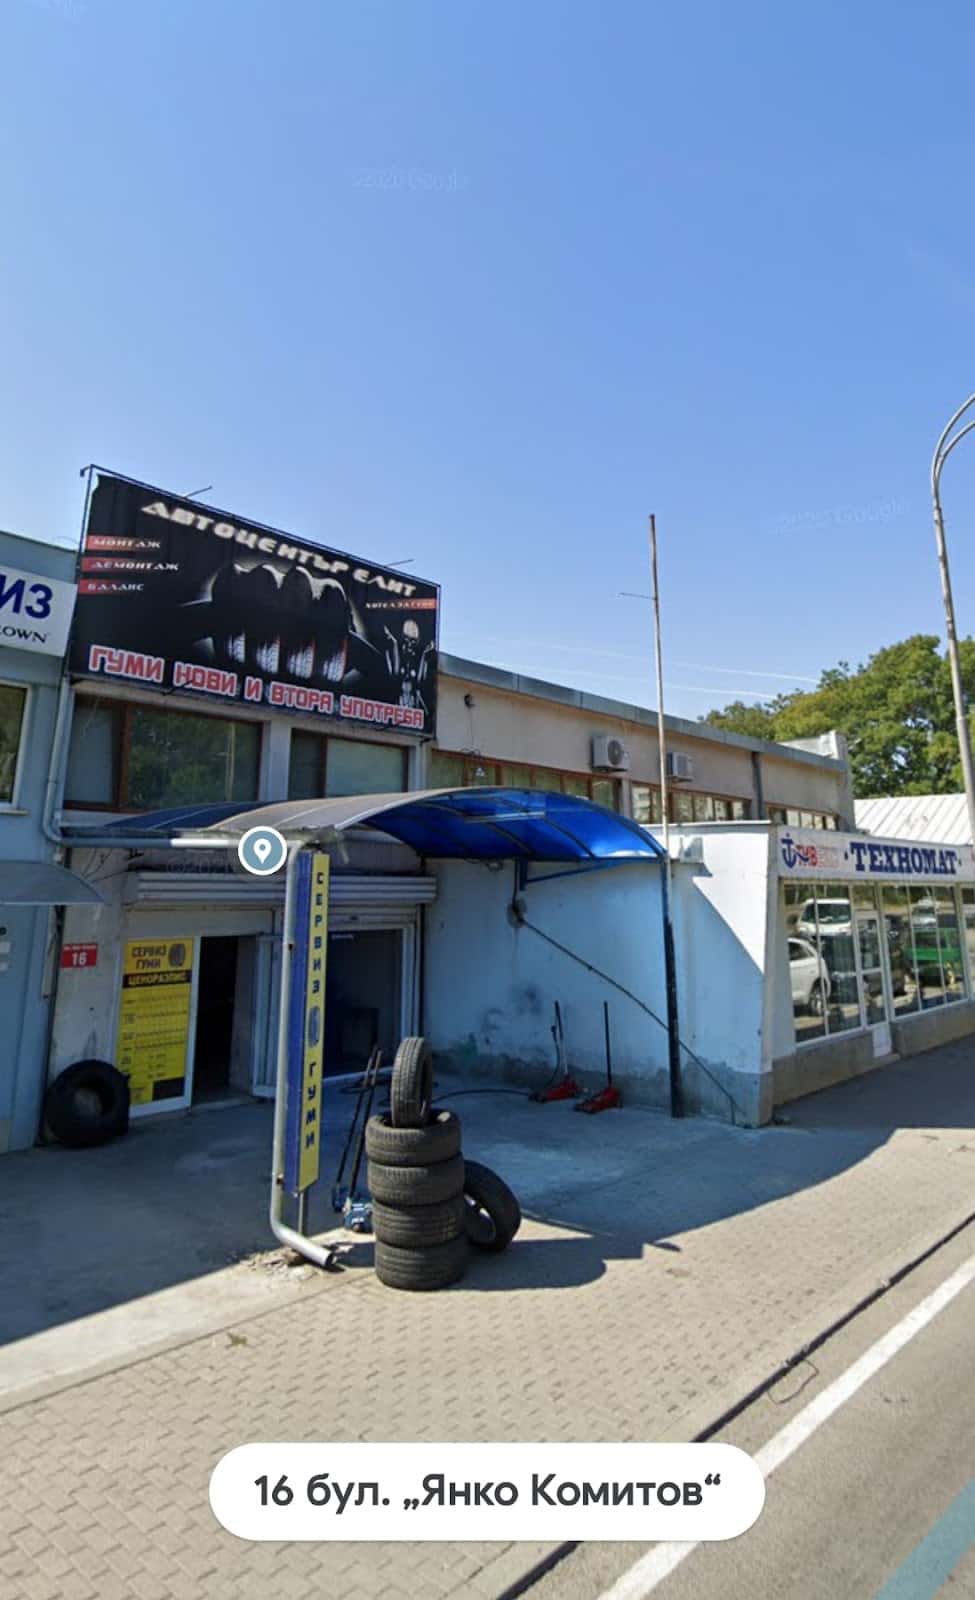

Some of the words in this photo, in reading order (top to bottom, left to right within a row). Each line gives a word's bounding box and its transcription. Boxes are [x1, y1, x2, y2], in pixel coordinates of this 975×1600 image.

[93, 539, 160, 549] МОНТАЖ
[140, 501, 349, 573] АВТОЦЕНТЪР
[353, 569, 417, 598] ЕЛИТ
[91, 561, 179, 571] ДЕМОНТАЖ
[88, 583, 144, 592] БАЛАНС
[0, 625, 48, 644] OWN
[89, 645, 164, 684] ГУМИ
[174, 662, 237, 697] НОВИ
[244, 675, 263, 701] И
[270, 682, 333, 716] ВТОРА
[340, 695, 425, 731] УПОТРЕБА
[850, 841, 957, 875] ТЕХНОМАТ
[312, 872, 324, 994] СЕРВИЗ
[72, 952, 88, 966] 16
[131, 944, 167, 958] СЕРВИЗ
[135, 958, 161, 970] ГУМИ
[305, 1062, 317, 1148] ГУМИ
